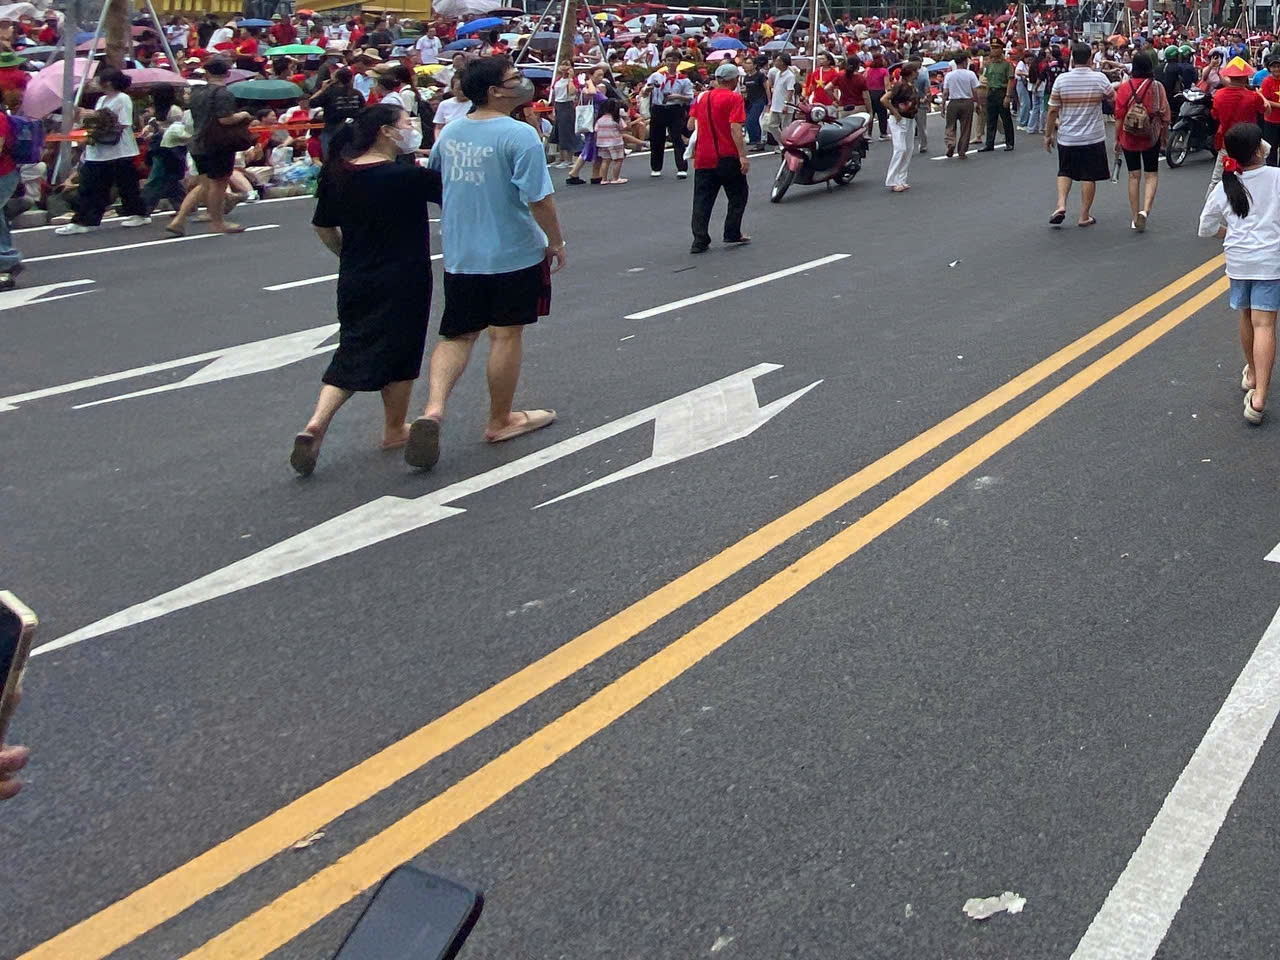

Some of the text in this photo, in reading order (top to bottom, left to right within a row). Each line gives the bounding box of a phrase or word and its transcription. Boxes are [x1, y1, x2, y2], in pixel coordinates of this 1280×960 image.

[445, 139, 494, 158] Seize
[453, 152, 483, 168] the
[449, 166, 486, 186] Day
